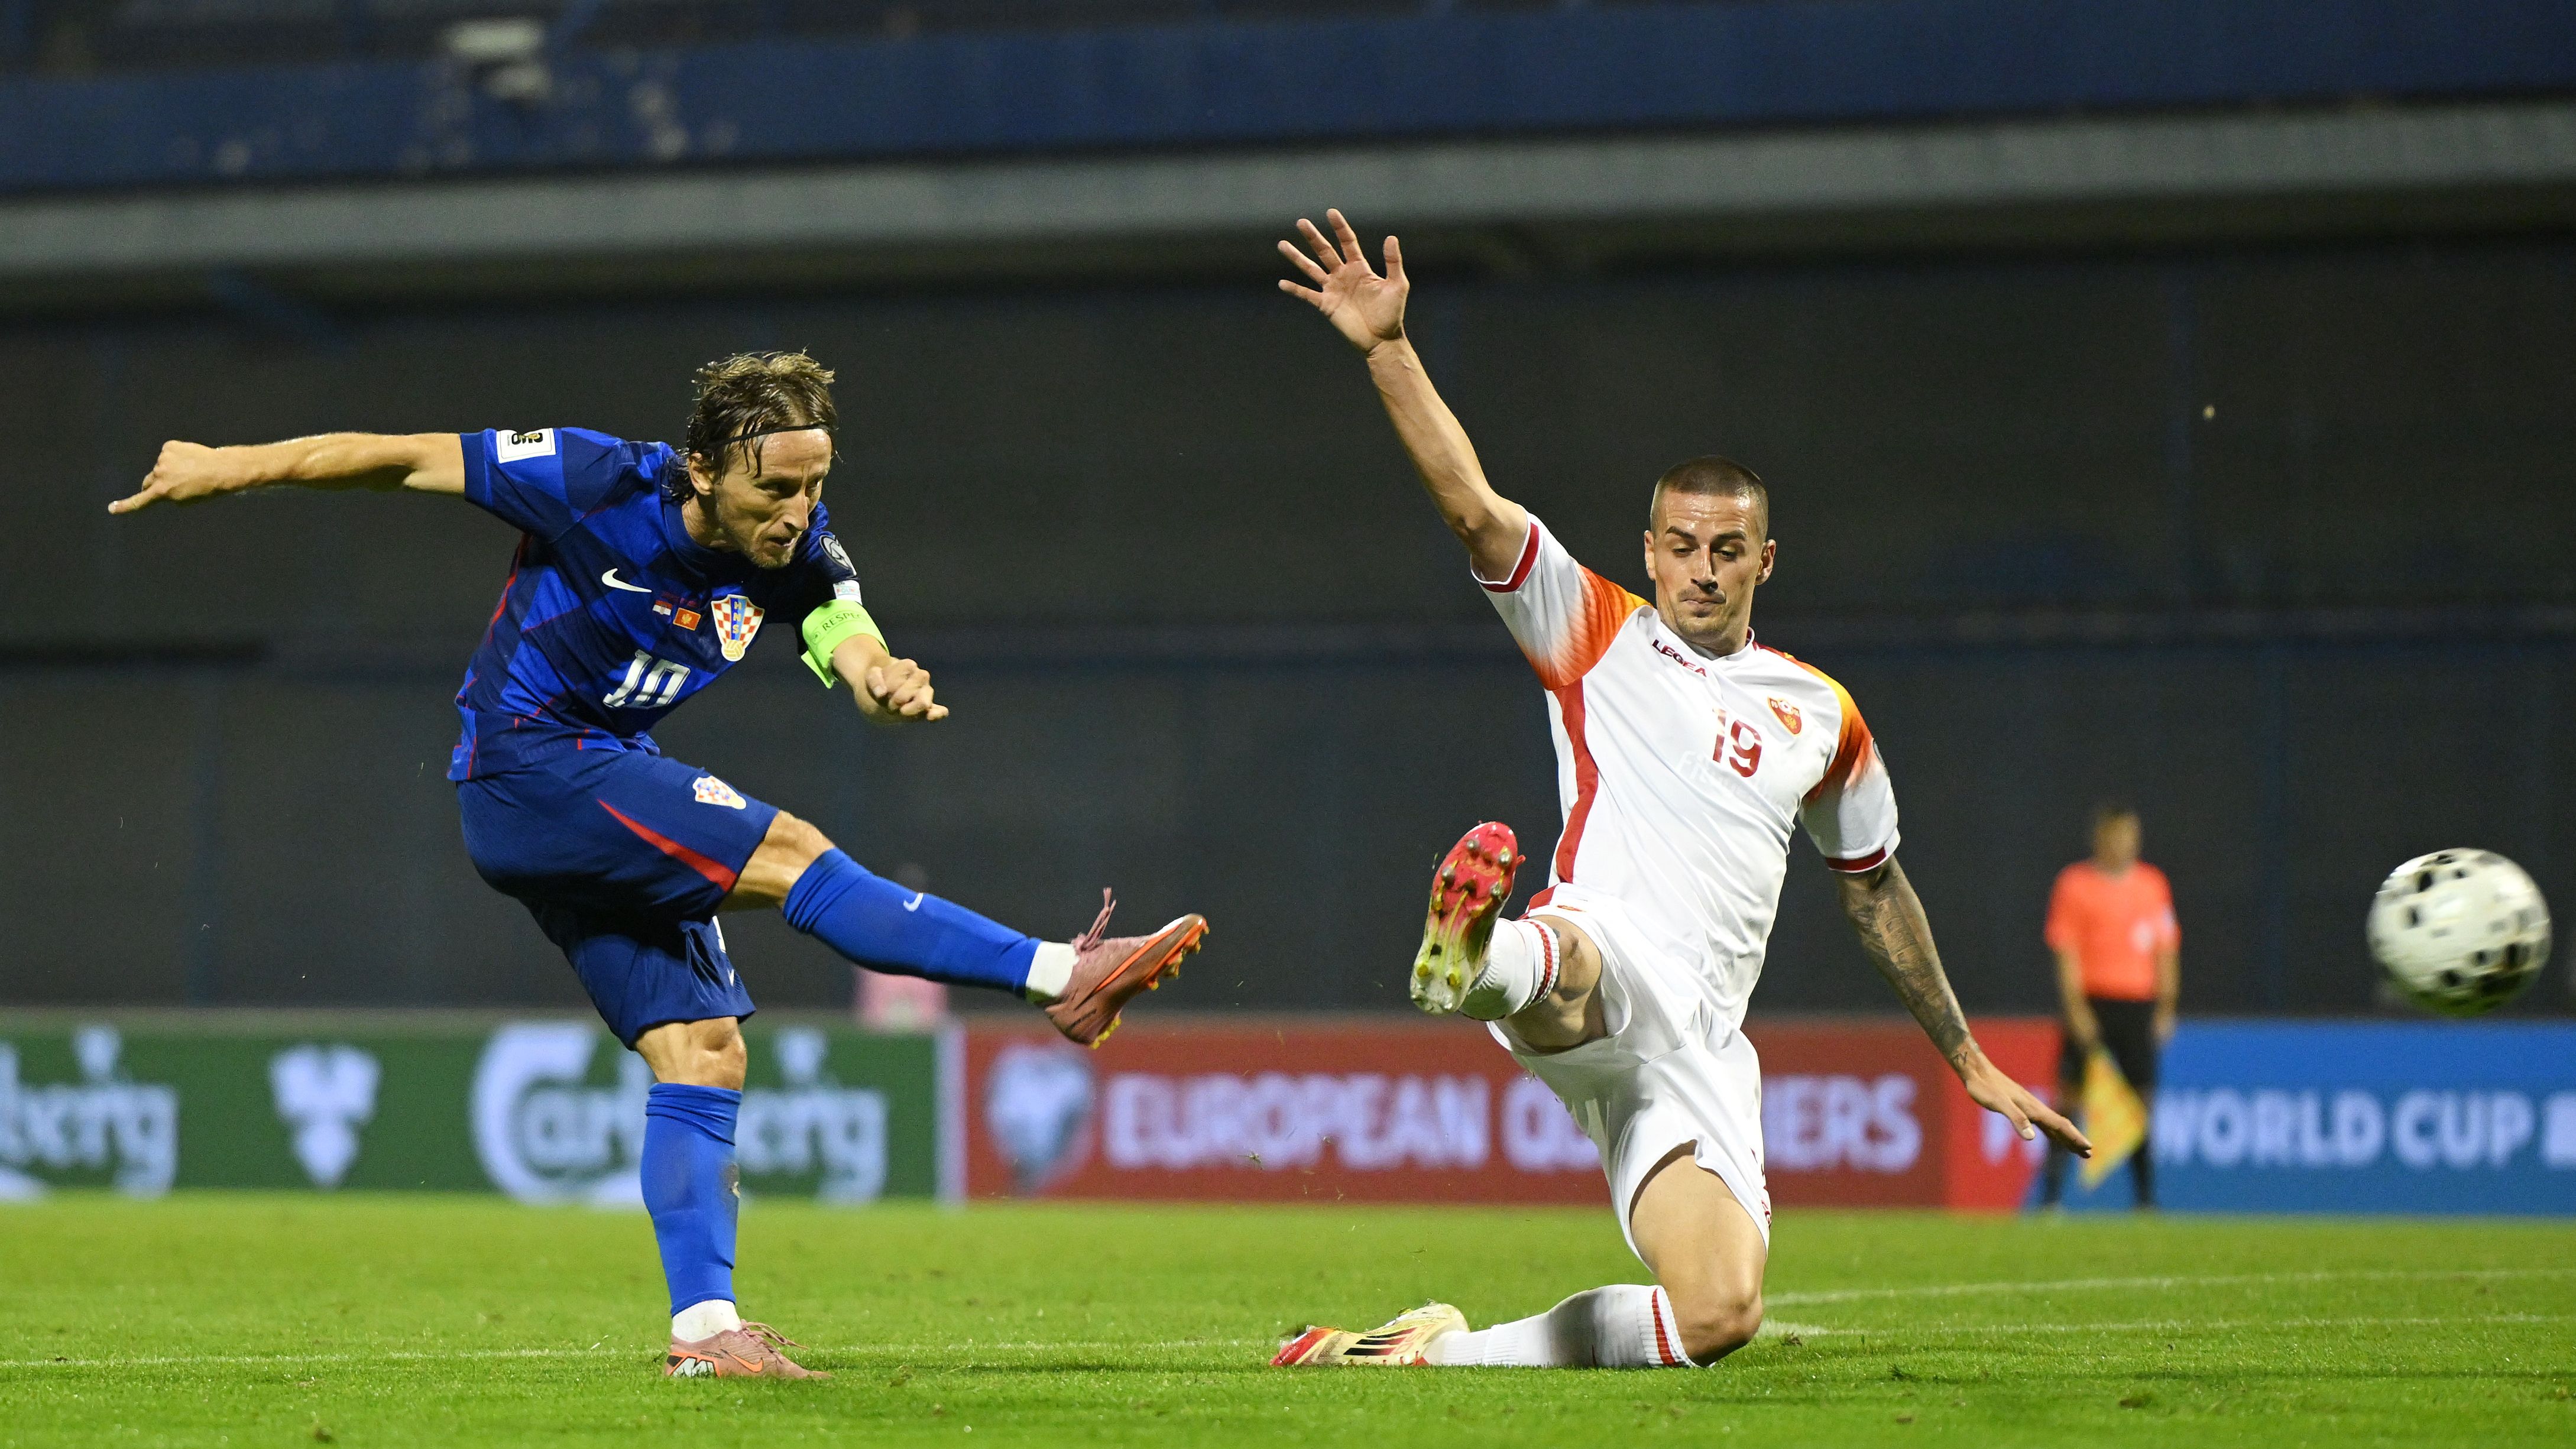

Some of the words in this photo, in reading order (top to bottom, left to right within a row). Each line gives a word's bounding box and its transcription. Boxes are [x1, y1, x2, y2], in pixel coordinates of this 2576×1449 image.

[602, 649, 691, 708] 10
[1652, 639, 1707, 678] LEGEA
[1712, 708, 1762, 777] 19
[1104, 1073, 1490, 1171] EUROPEAN
[2152, 1088, 2384, 1166] WORLD
[2394, 1088, 2533, 1166] CUP
